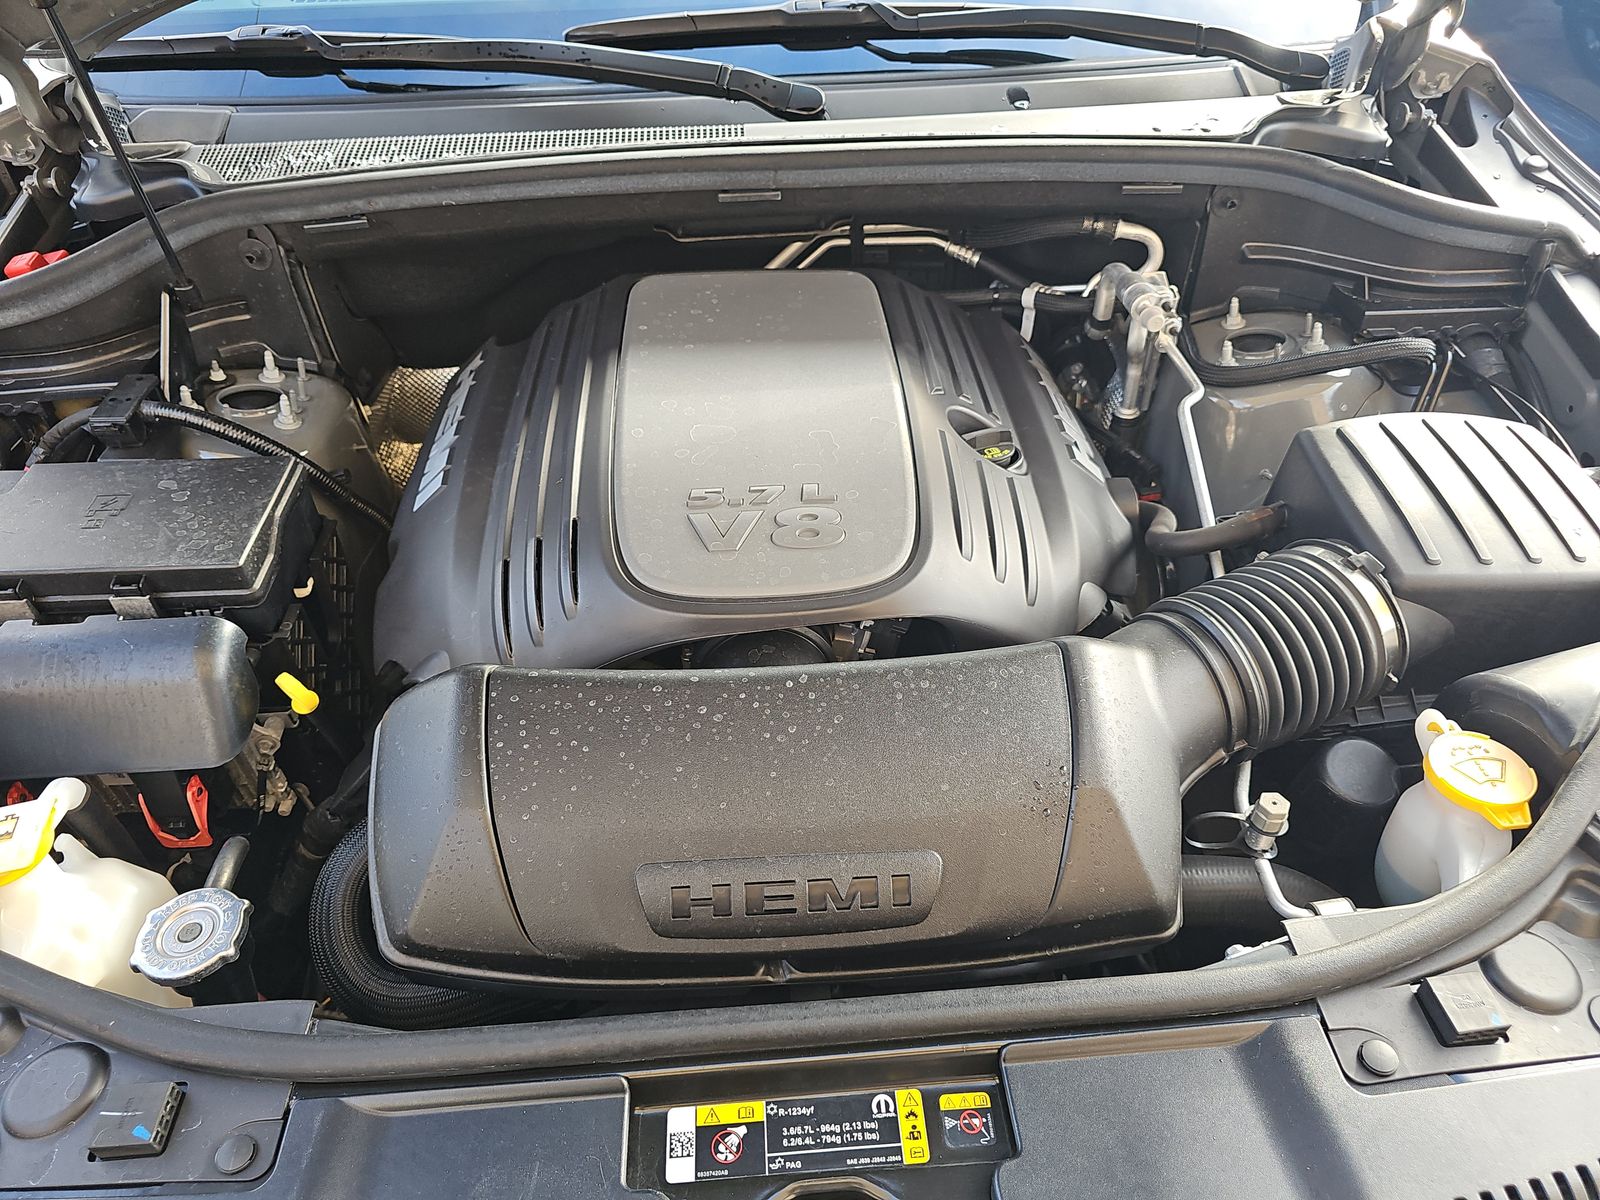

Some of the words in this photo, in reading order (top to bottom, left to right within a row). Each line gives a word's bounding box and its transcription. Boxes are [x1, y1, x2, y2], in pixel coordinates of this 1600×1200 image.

[686, 506, 847, 552] V8
[670, 864, 912, 920] HEMI
[778, 1106, 815, 1117] R-1234yf
[782, 1125, 815, 1136] 3.6/5.7L
[820, 1123, 841, 1134] 964g
[842, 1121, 862, 1132] (2.13
[863, 1120, 879, 1131] lbs)
[782, 1136, 816, 1147] 6.2/6.4L
[821, 1134, 842, 1145] 794g
[843, 1132, 863, 1143] (1.75
[864, 1130, 880, 1141] lbs)
[785, 1160, 802, 1170] PAG
